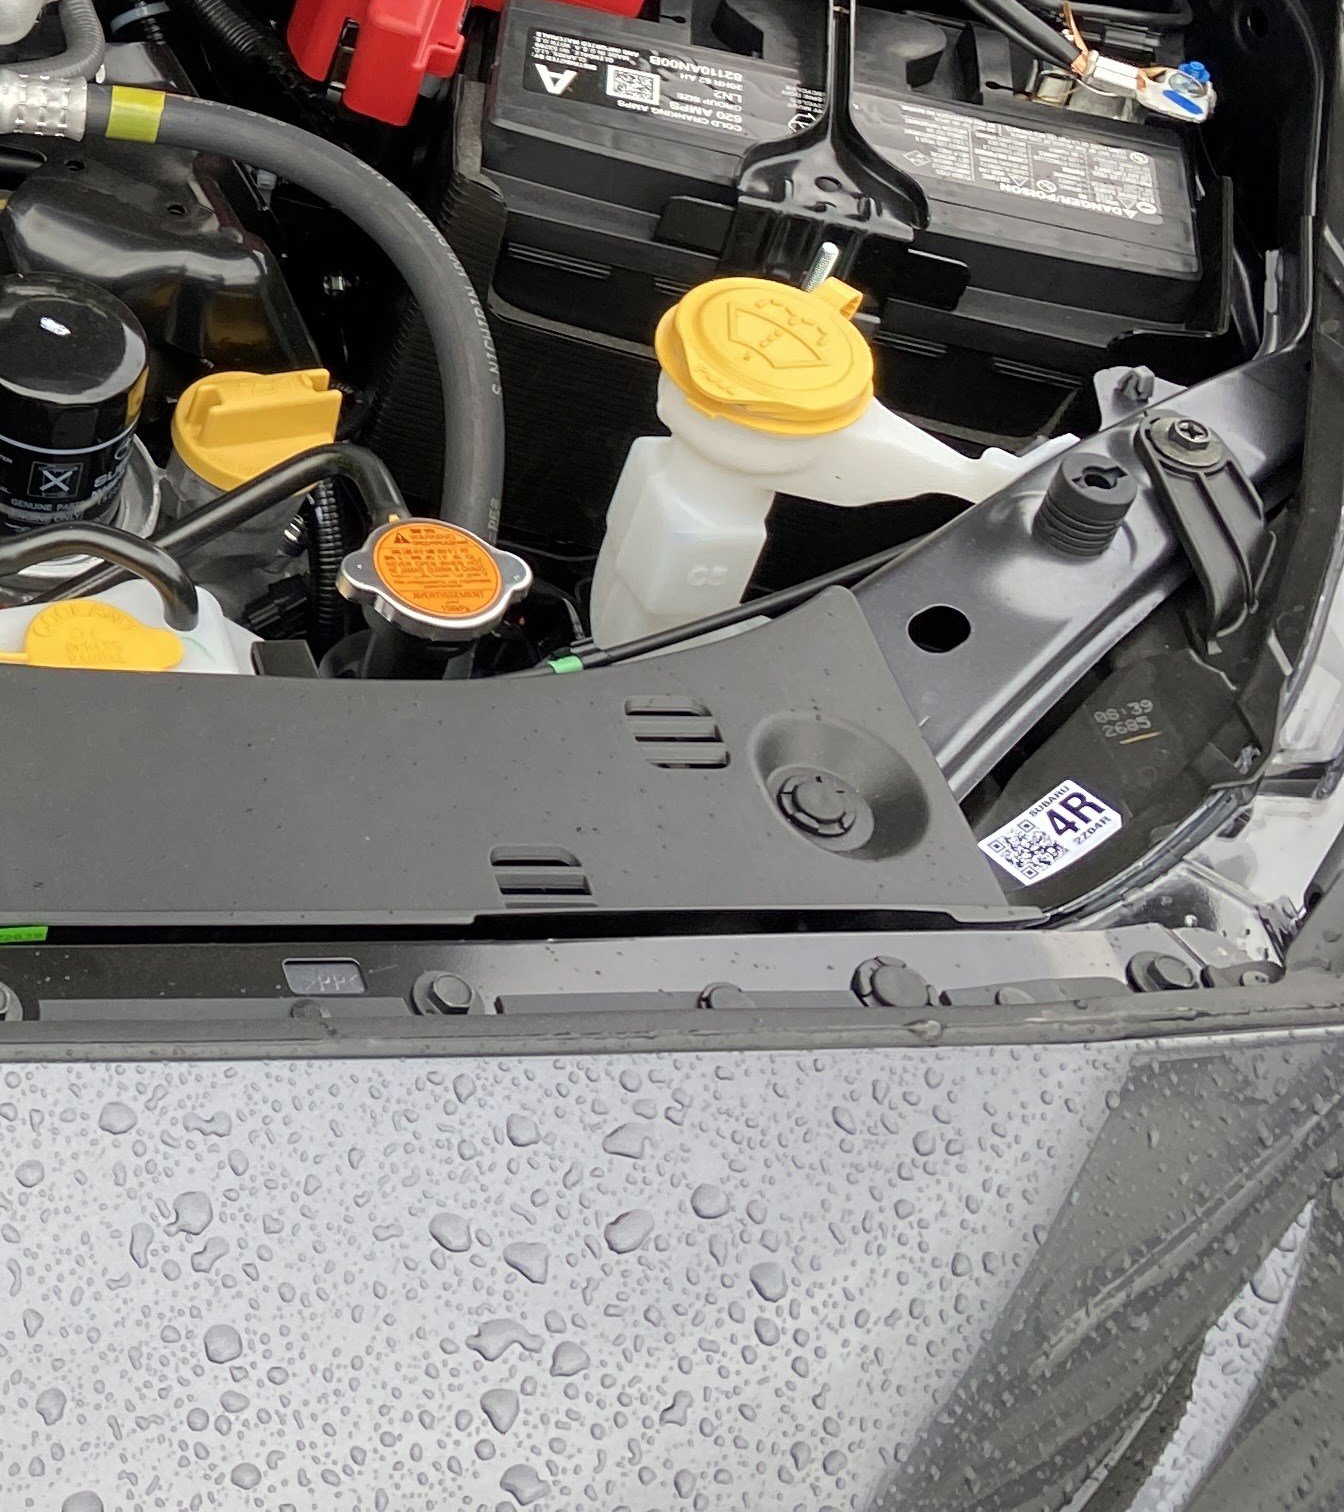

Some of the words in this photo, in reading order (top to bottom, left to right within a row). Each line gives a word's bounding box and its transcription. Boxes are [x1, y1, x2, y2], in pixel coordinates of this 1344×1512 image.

[534, 63, 578, 96] A
[676, 92, 701, 103] SIZE
[713, 90, 743, 103] LN2
[616, 100, 650, 112] AMPS
[669, 101, 713, 117] AMPS
[702, 99, 743, 112] GROUP
[651, 107, 710, 125] CRANKING
[716, 111, 743, 123] 620
[711, 119, 743, 132] COLD
[1000, 183, 1124, 217] DANGER/POISON
[11, 498, 53, 512] GENUINE
[1028, 785, 1070, 818] SUBARU
[1046, 791, 1106, 836] 4R
